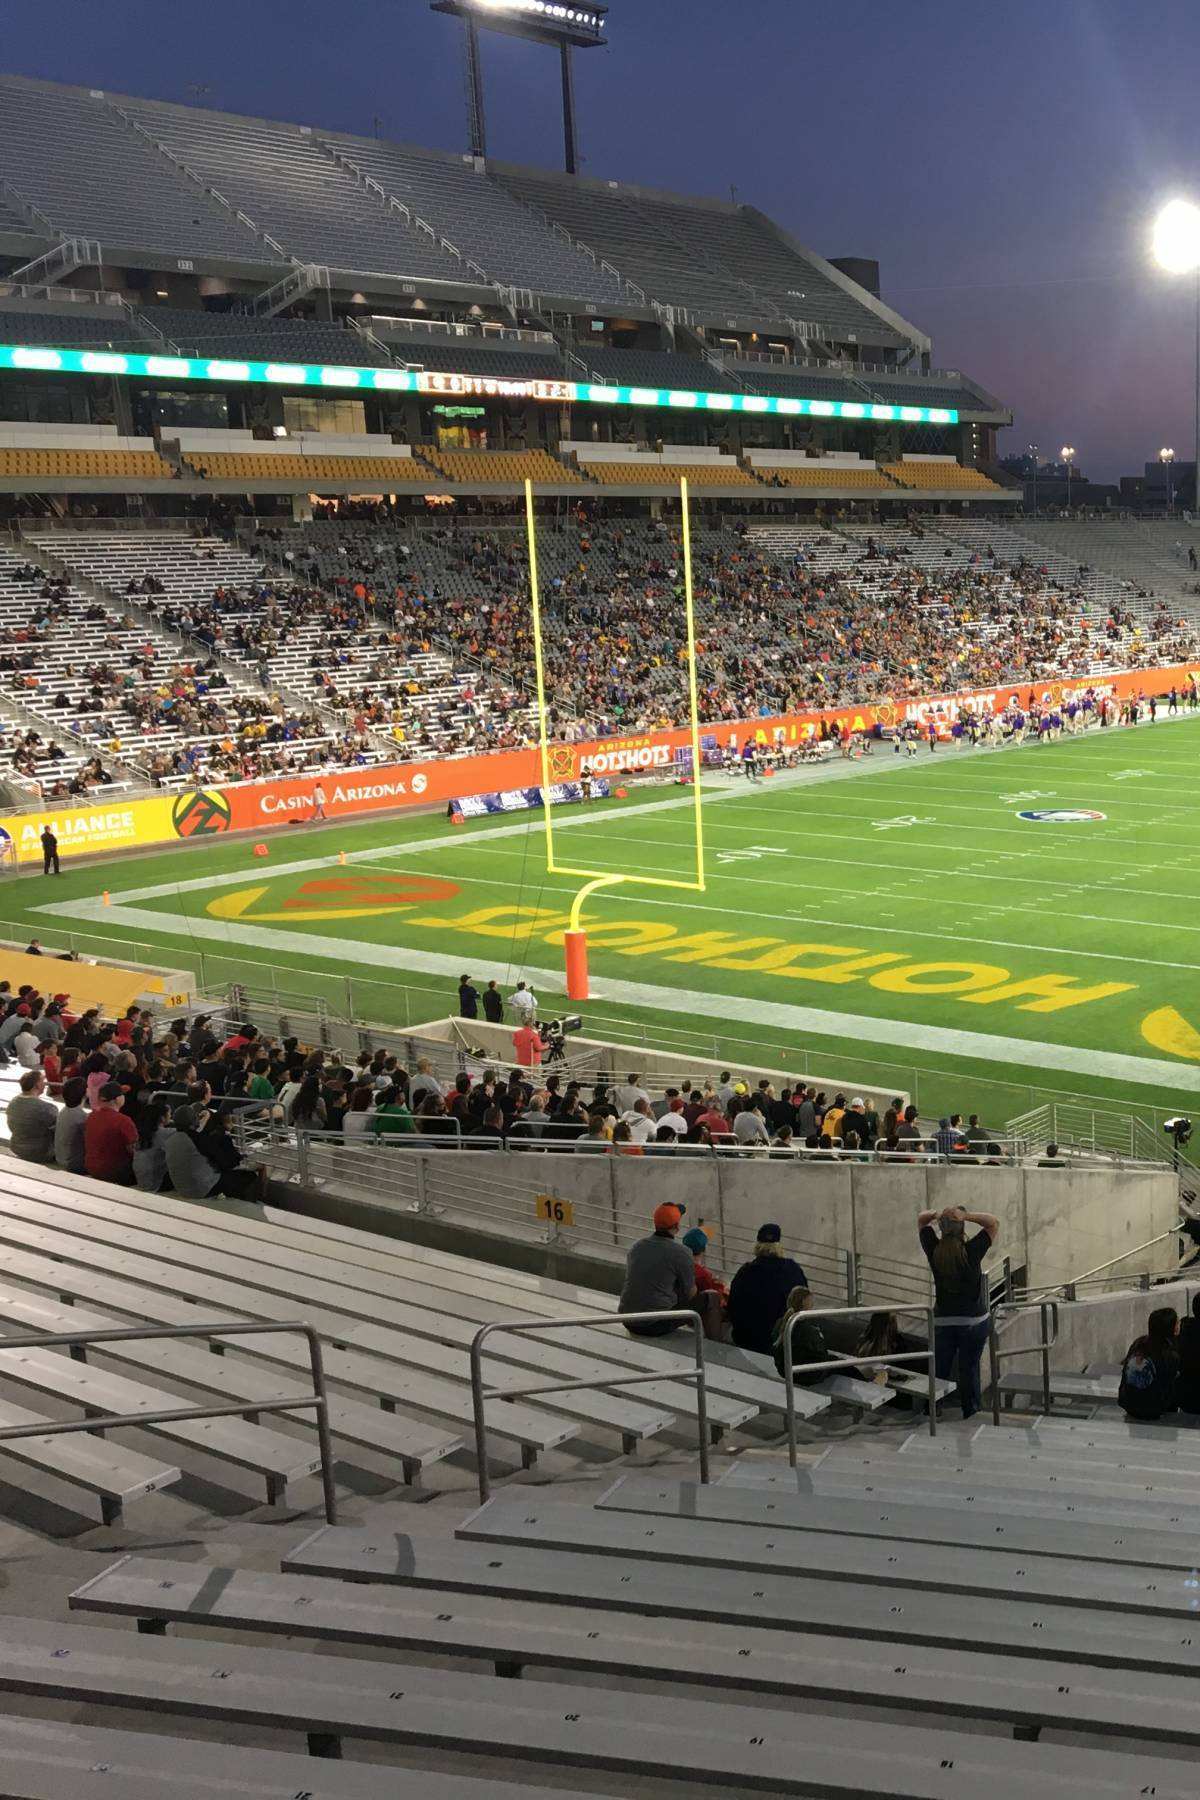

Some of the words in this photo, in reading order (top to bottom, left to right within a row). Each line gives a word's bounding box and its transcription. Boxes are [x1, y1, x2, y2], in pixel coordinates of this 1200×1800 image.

[579, 744, 671, 774] HOTSHOTS
[598, 738, 650, 752] ARIZONA
[260, 793, 318, 813] CASIN
[331, 783, 407, 804] ARIZONA
[21, 811, 135, 841] ALLIANCE
[402, 904, 1140, 1013] HOTSHOTS
[170, 995, 182, 1005] 18
[544, 1200, 564, 1221] 16
